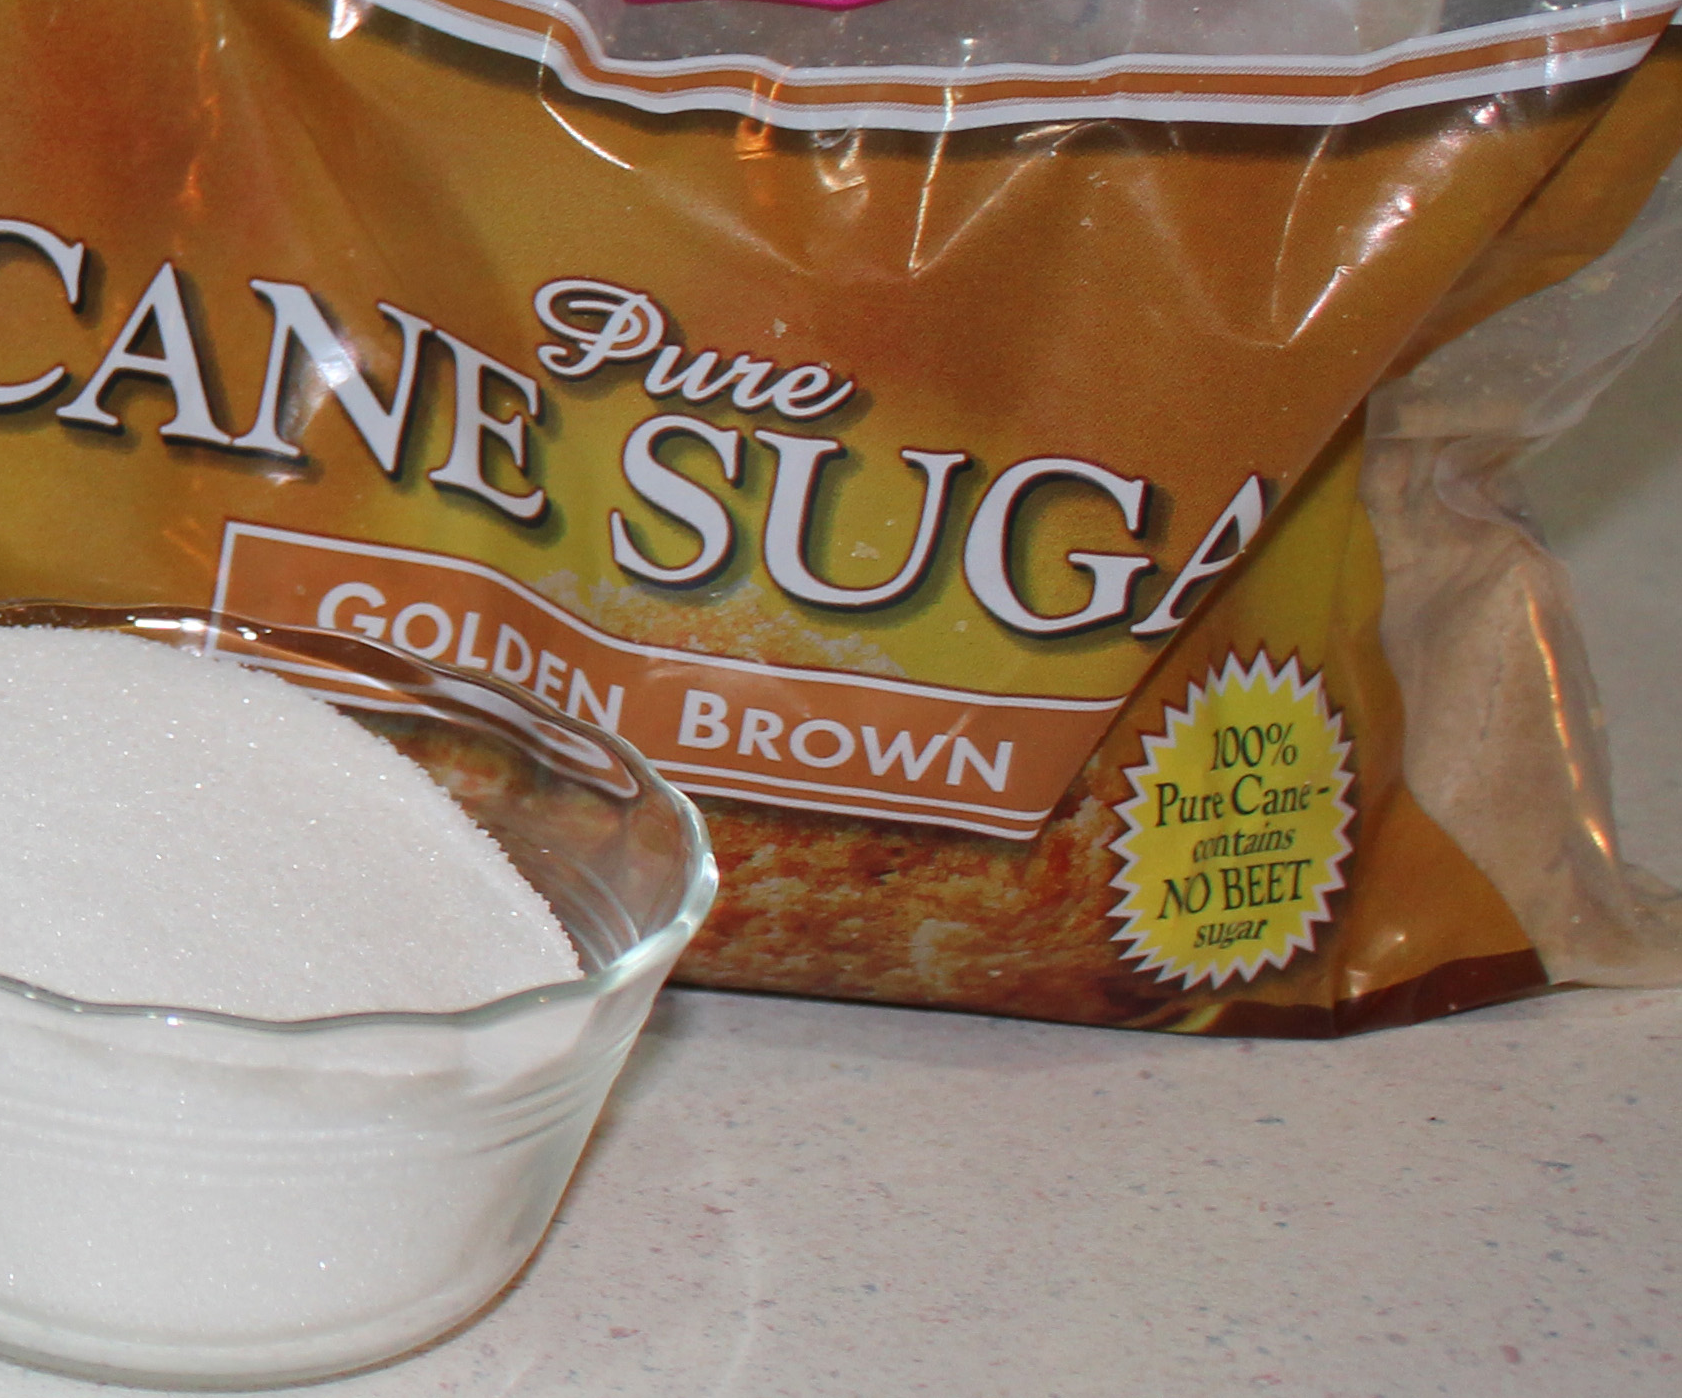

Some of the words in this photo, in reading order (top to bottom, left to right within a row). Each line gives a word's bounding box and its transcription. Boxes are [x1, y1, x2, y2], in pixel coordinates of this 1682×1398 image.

[532, 276, 855, 421] Pure
[316, 581, 626, 734] GOLDEN
[677, 686, 1016, 795] BROWN
[1209, 722, 1300, 773] 100%
[1154, 781, 1225, 829] Pure
[1192, 820, 1297, 864] contains
[1156, 871, 1213, 921] NO
[1219, 858, 1313, 913] BEET
[1192, 917, 1269, 950] sugar
